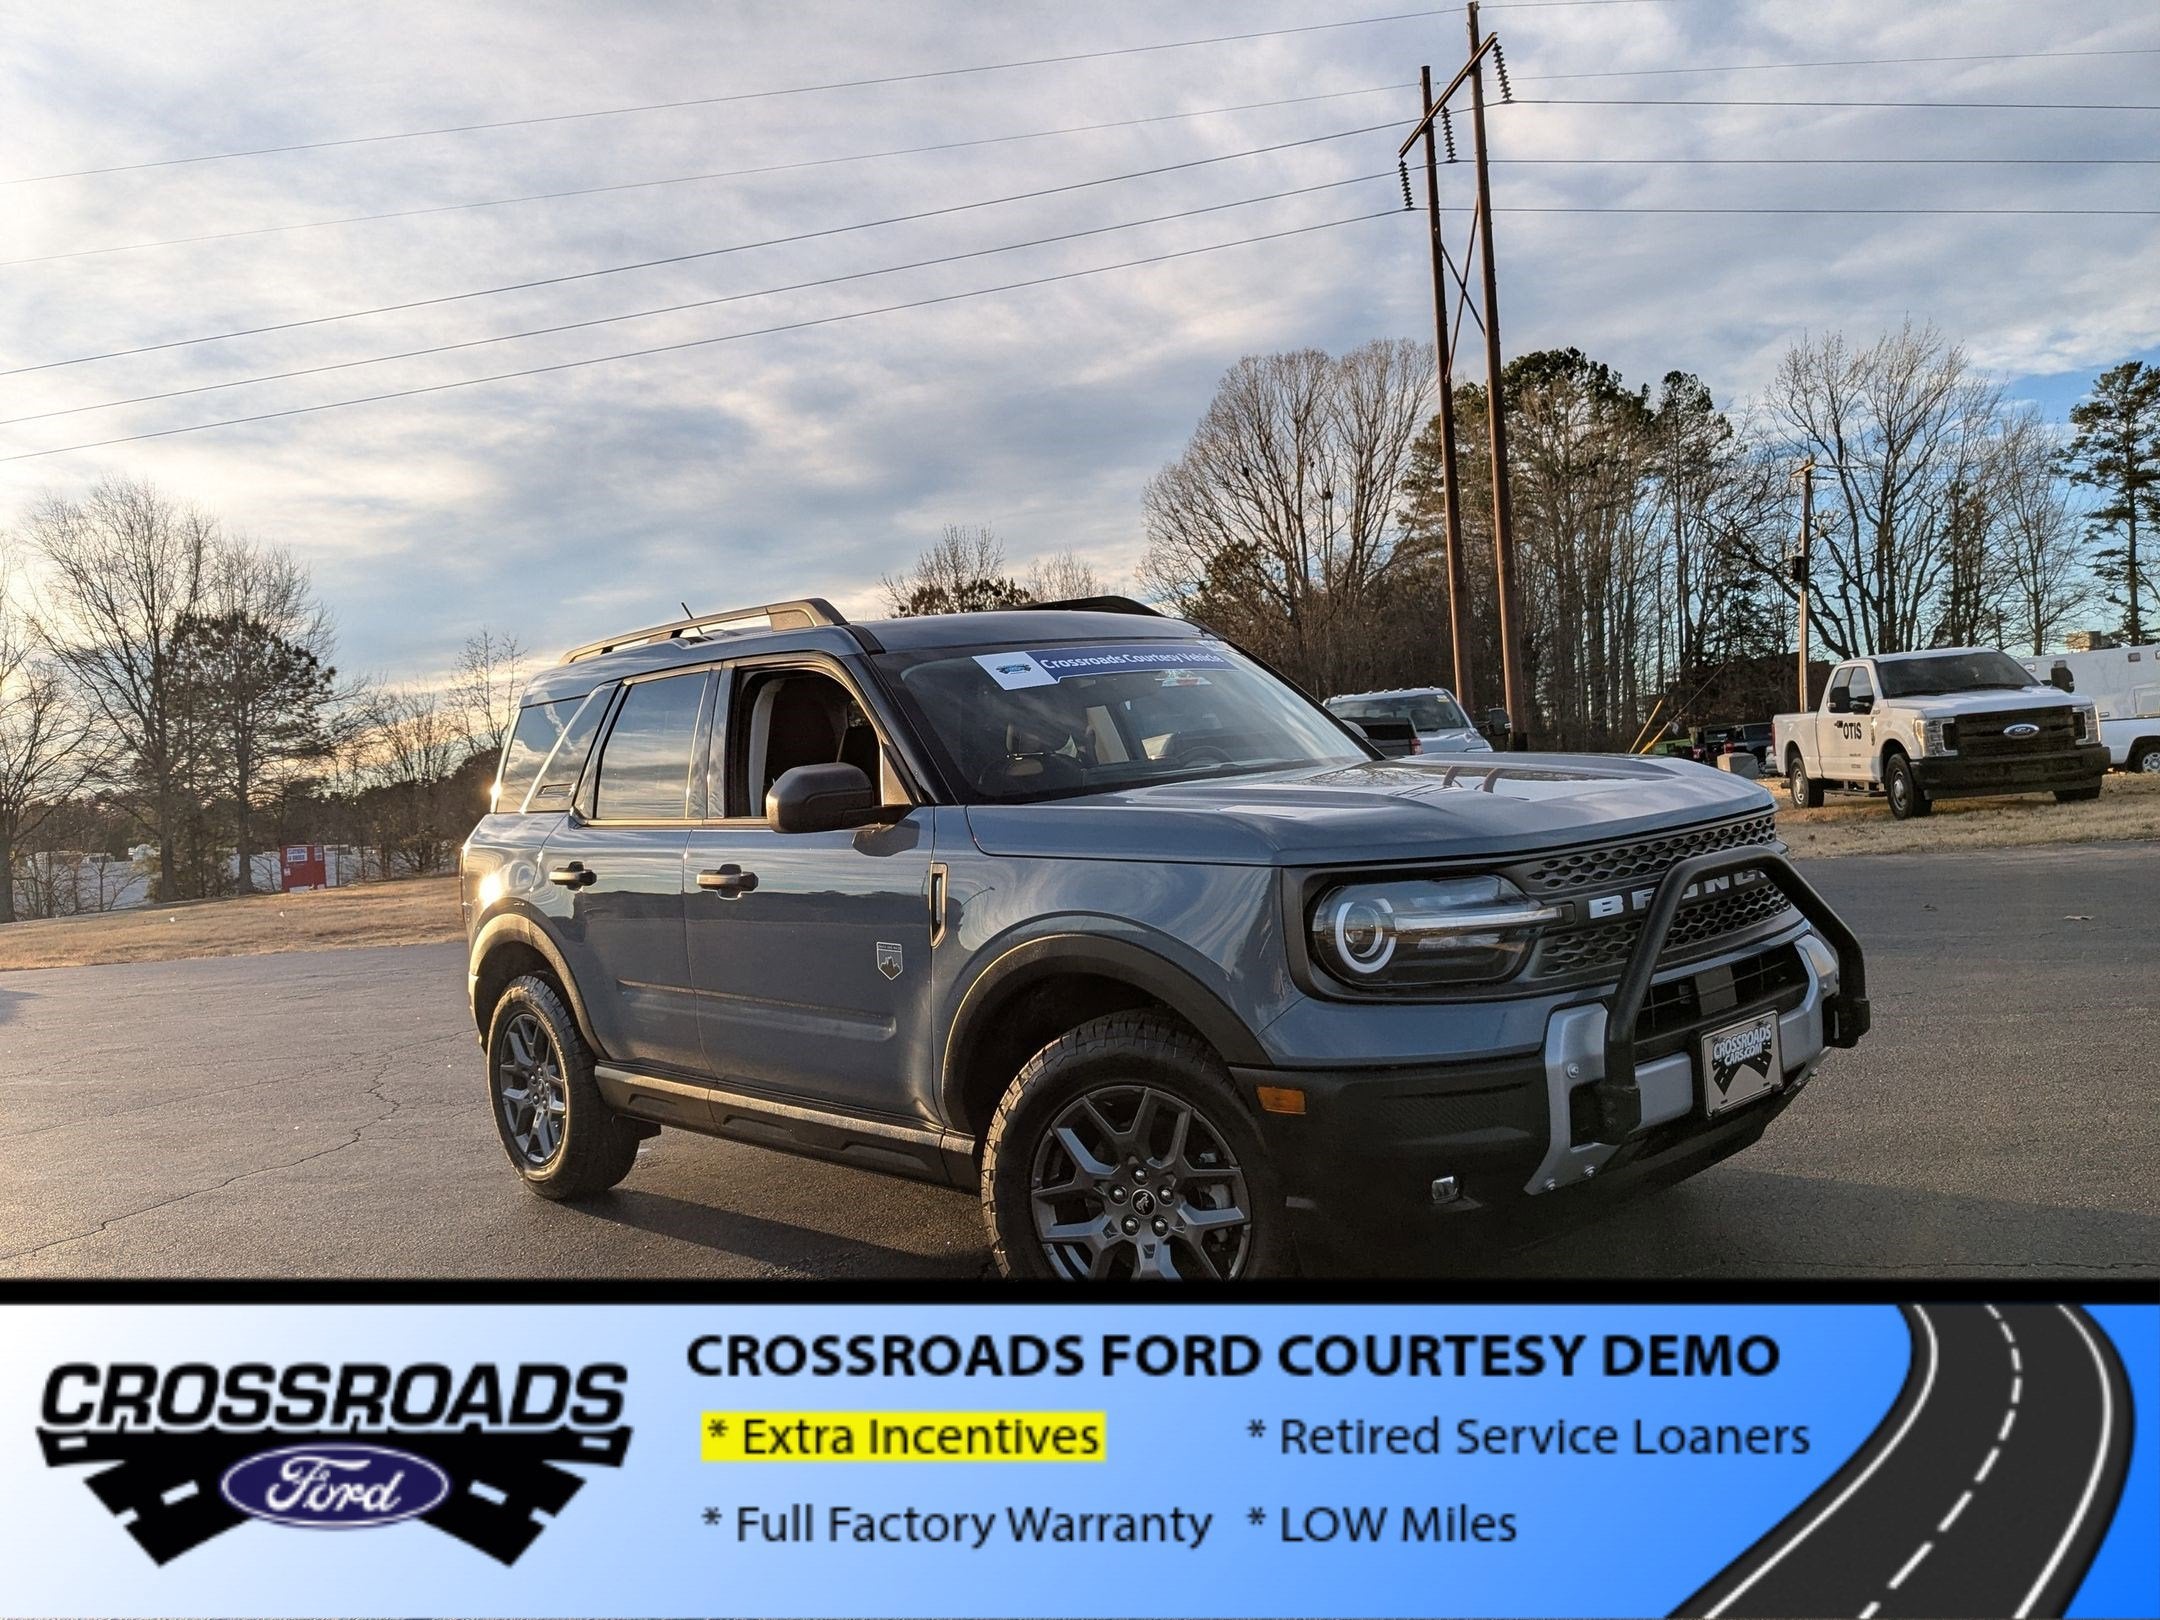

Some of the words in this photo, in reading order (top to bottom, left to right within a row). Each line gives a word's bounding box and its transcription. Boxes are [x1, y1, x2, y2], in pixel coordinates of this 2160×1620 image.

[1041, 655, 1126, 669] Crossroads
[1125, 653, 1183, 664] Courtesy
[1179, 652, 1224, 663] Vehicle
[1842, 721, 1862, 740] OTIS
[1713, 1023, 1772, 1061] CROSSROADS
[1724, 1042, 1763, 1067] CARS.COM
